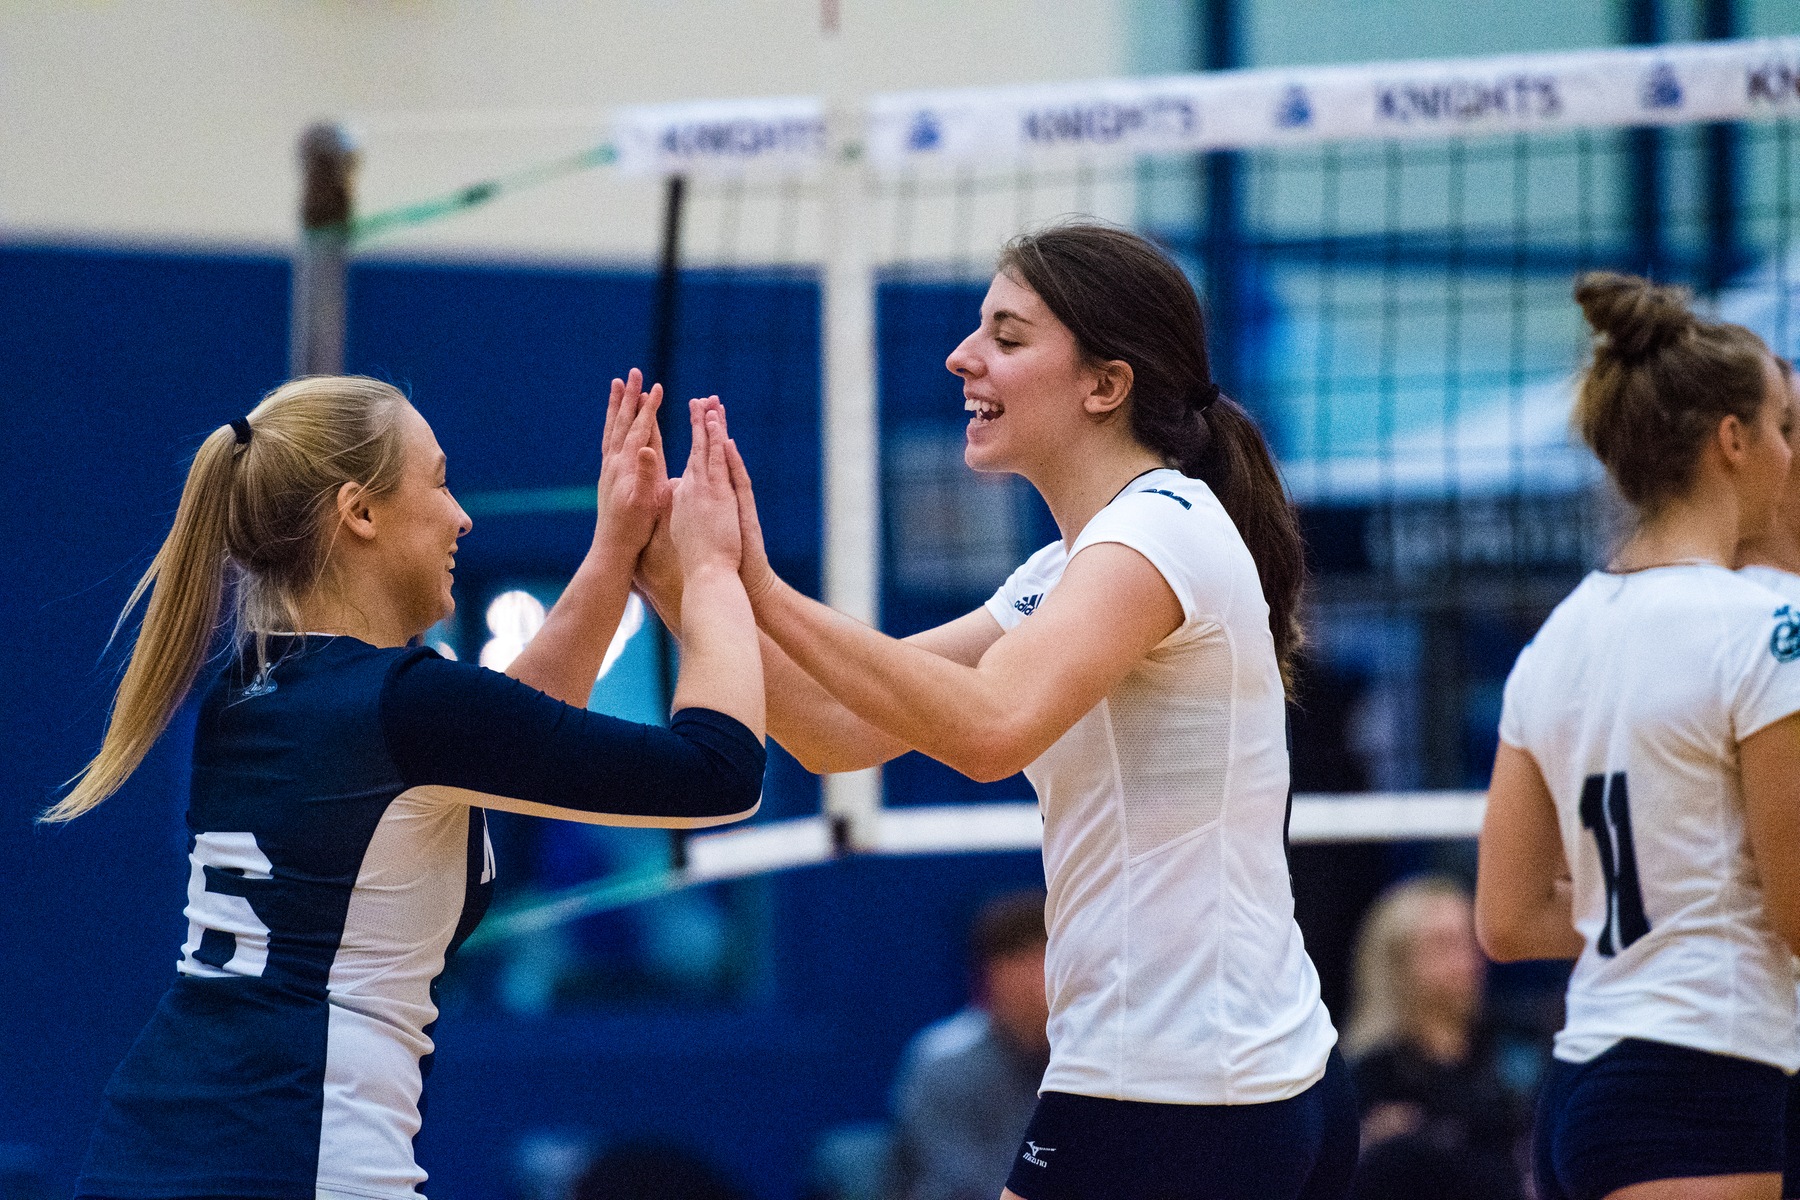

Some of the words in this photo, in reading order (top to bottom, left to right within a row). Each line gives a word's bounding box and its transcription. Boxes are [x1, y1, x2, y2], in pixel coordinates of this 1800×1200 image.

[1020, 95, 1196, 143] KNIGHTS
[1373, 74, 1563, 121] KNIGHTS
[1014, 600, 1036, 616] adid
[1579, 771, 1652, 958] 11
[176, 831, 273, 978] 6
